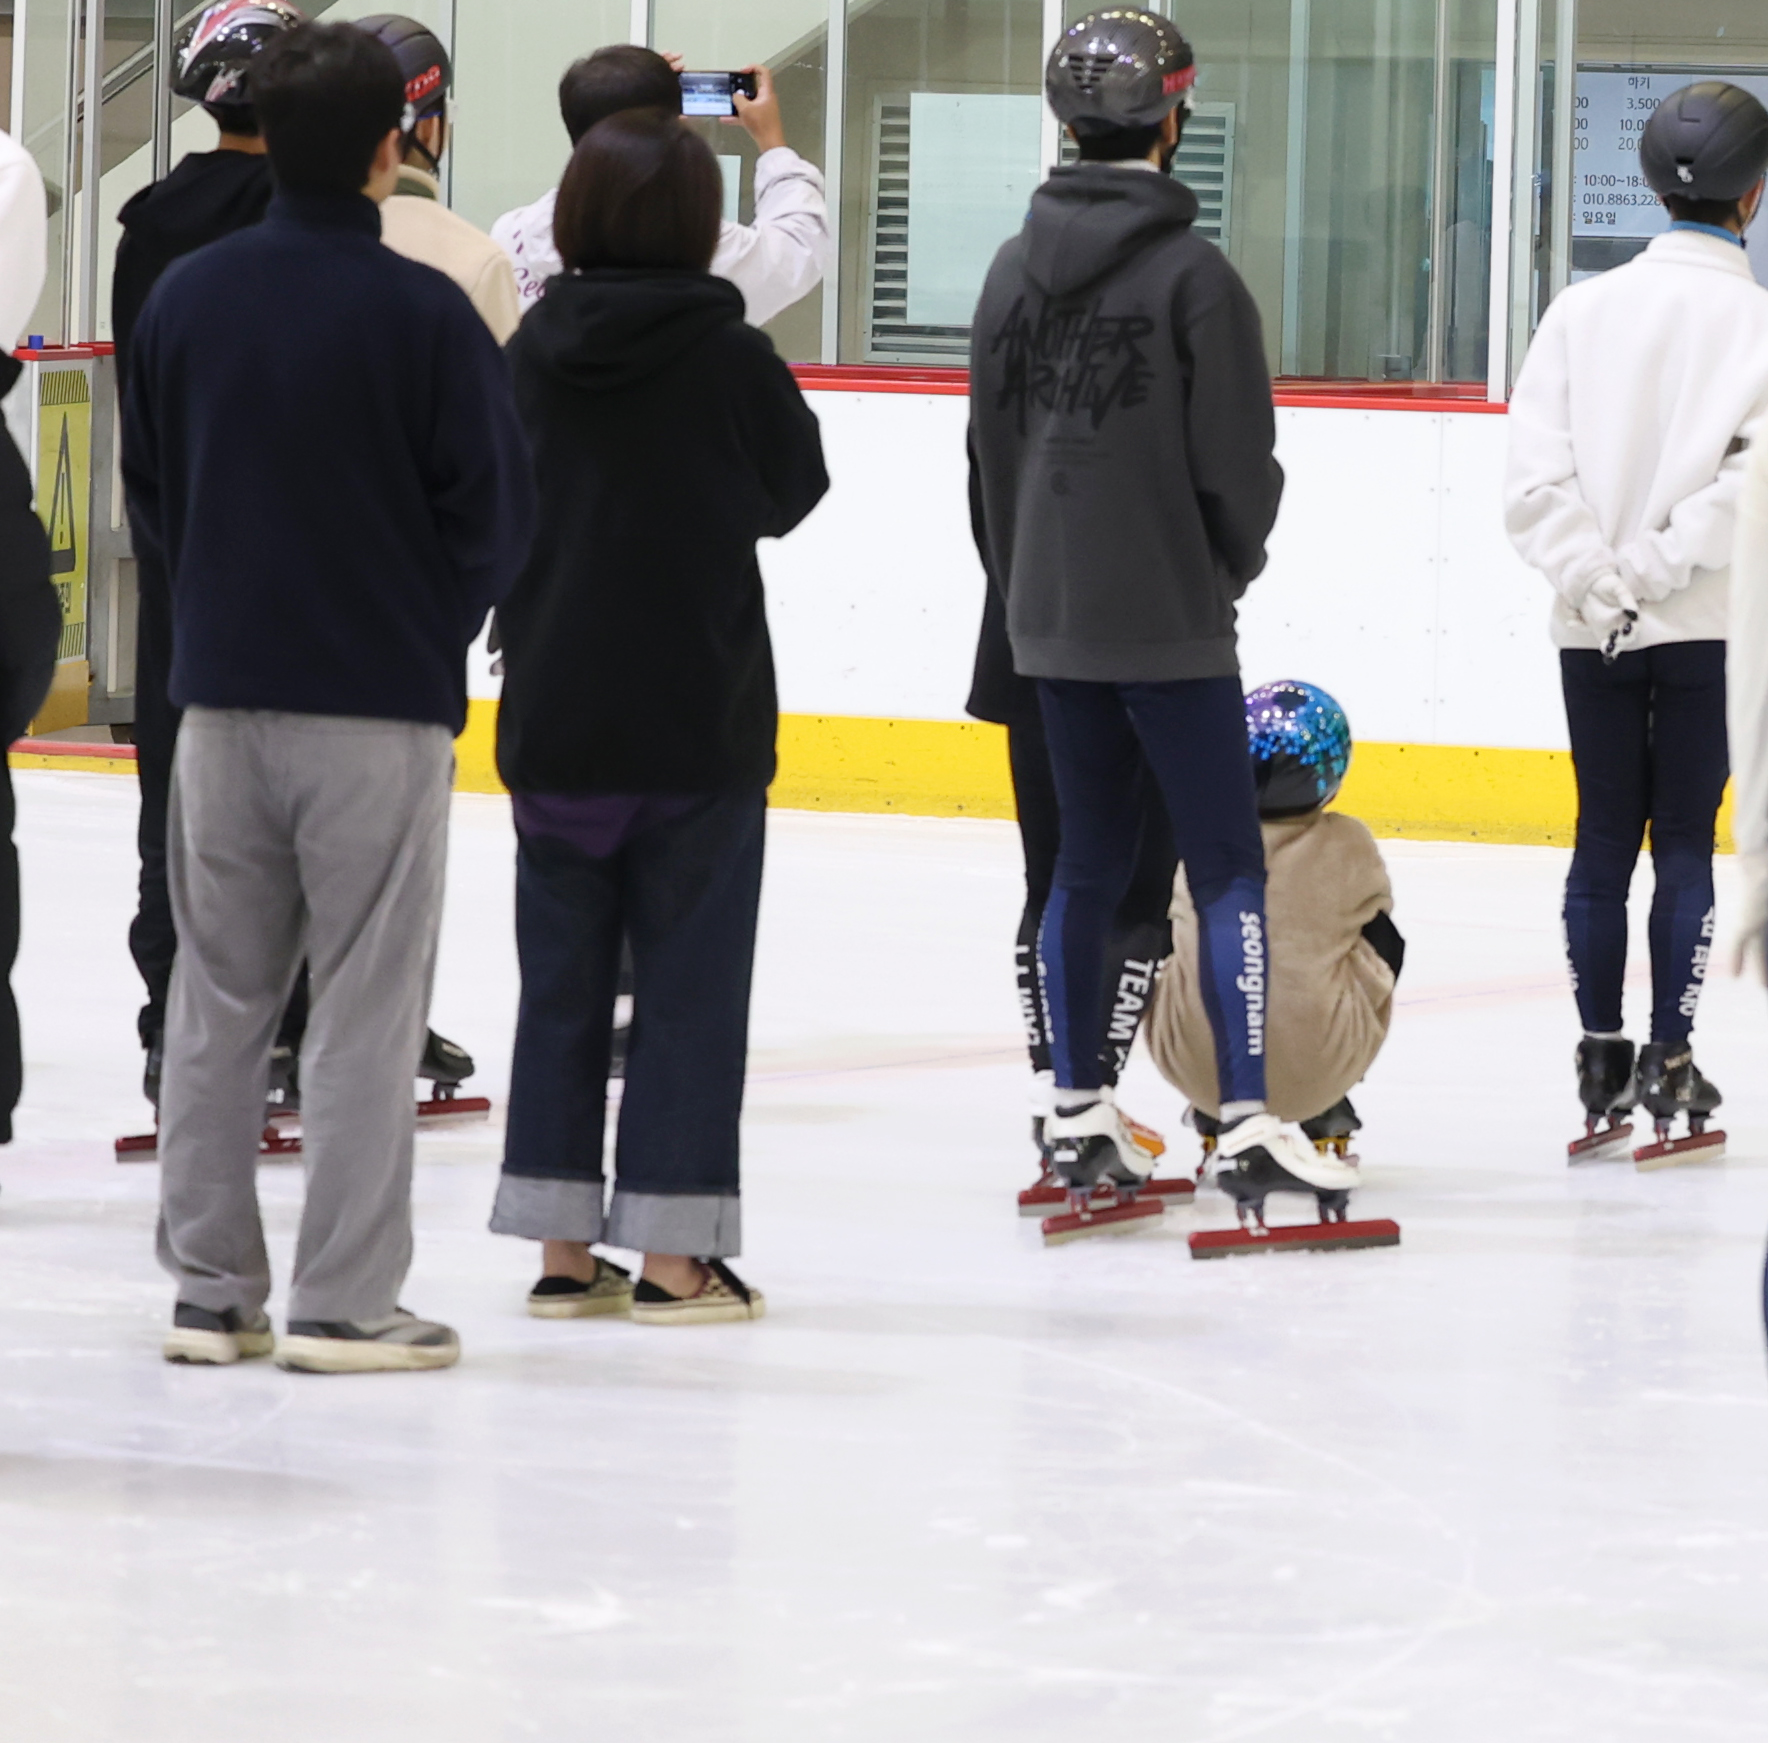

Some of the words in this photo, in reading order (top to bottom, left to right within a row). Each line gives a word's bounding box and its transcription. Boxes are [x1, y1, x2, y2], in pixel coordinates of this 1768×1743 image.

[1582, 211, 1617, 225] 일요일
[1106, 958, 1156, 1041] TEAM
[1236, 910, 1266, 1056] seongnam
